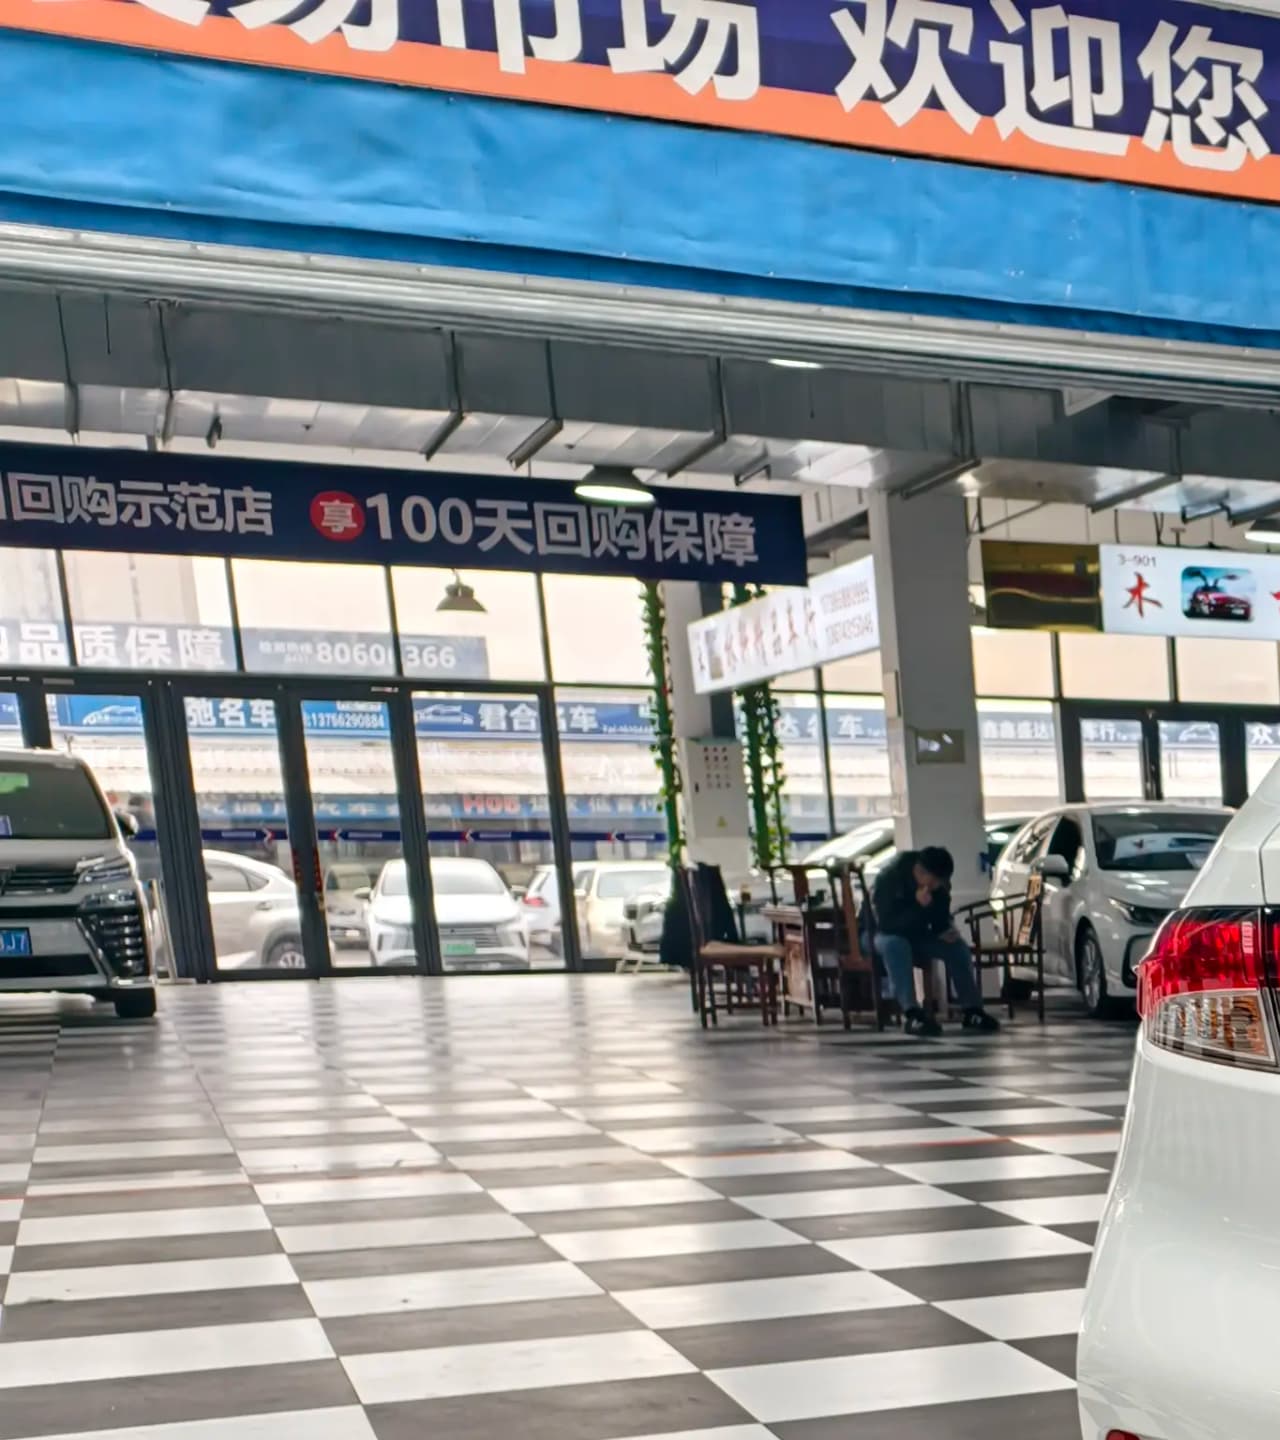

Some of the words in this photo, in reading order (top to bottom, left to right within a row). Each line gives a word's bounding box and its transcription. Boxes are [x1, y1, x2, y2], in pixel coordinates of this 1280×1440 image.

[831, 0, 1271, 172] 欢迎您
[0, 471, 274, 536] 回购示范店
[317, 498, 358, 534] 享
[366, 492, 759, 568] 100天回购保障
[1122, 571, 1163, 618] 木
[0, 622, 226, 671] 品质保障
[316, 640, 457, 669] 8060366
